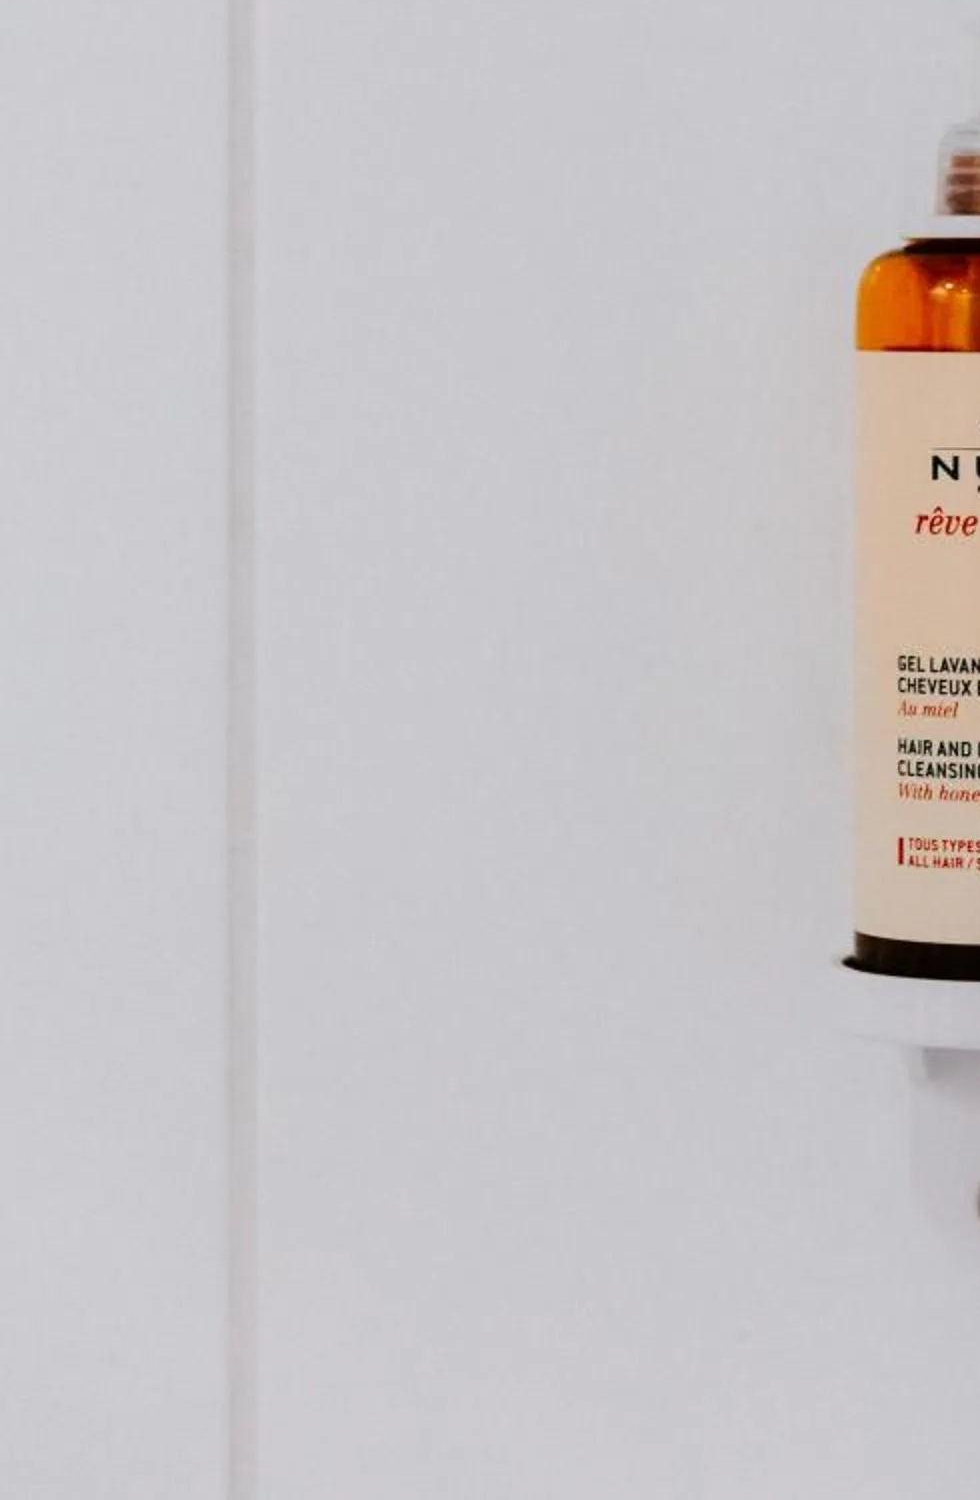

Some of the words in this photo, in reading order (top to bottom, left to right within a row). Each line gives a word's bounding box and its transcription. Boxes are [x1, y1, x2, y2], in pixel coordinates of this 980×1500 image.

[915, 507, 978, 536] rêve
[897, 655, 926, 673] GEL
[897, 677, 972, 697] CHEVEUX
[897, 701, 918, 717] Au
[922, 702, 959, 718] miel
[897, 739, 933, 756] HAIR
[937, 741, 972, 757] AND
[897, 783, 933, 800] With
[908, 837, 939, 851] TOUS
[908, 857, 928, 868] ALL
[932, 858, 963, 869] HAIR
